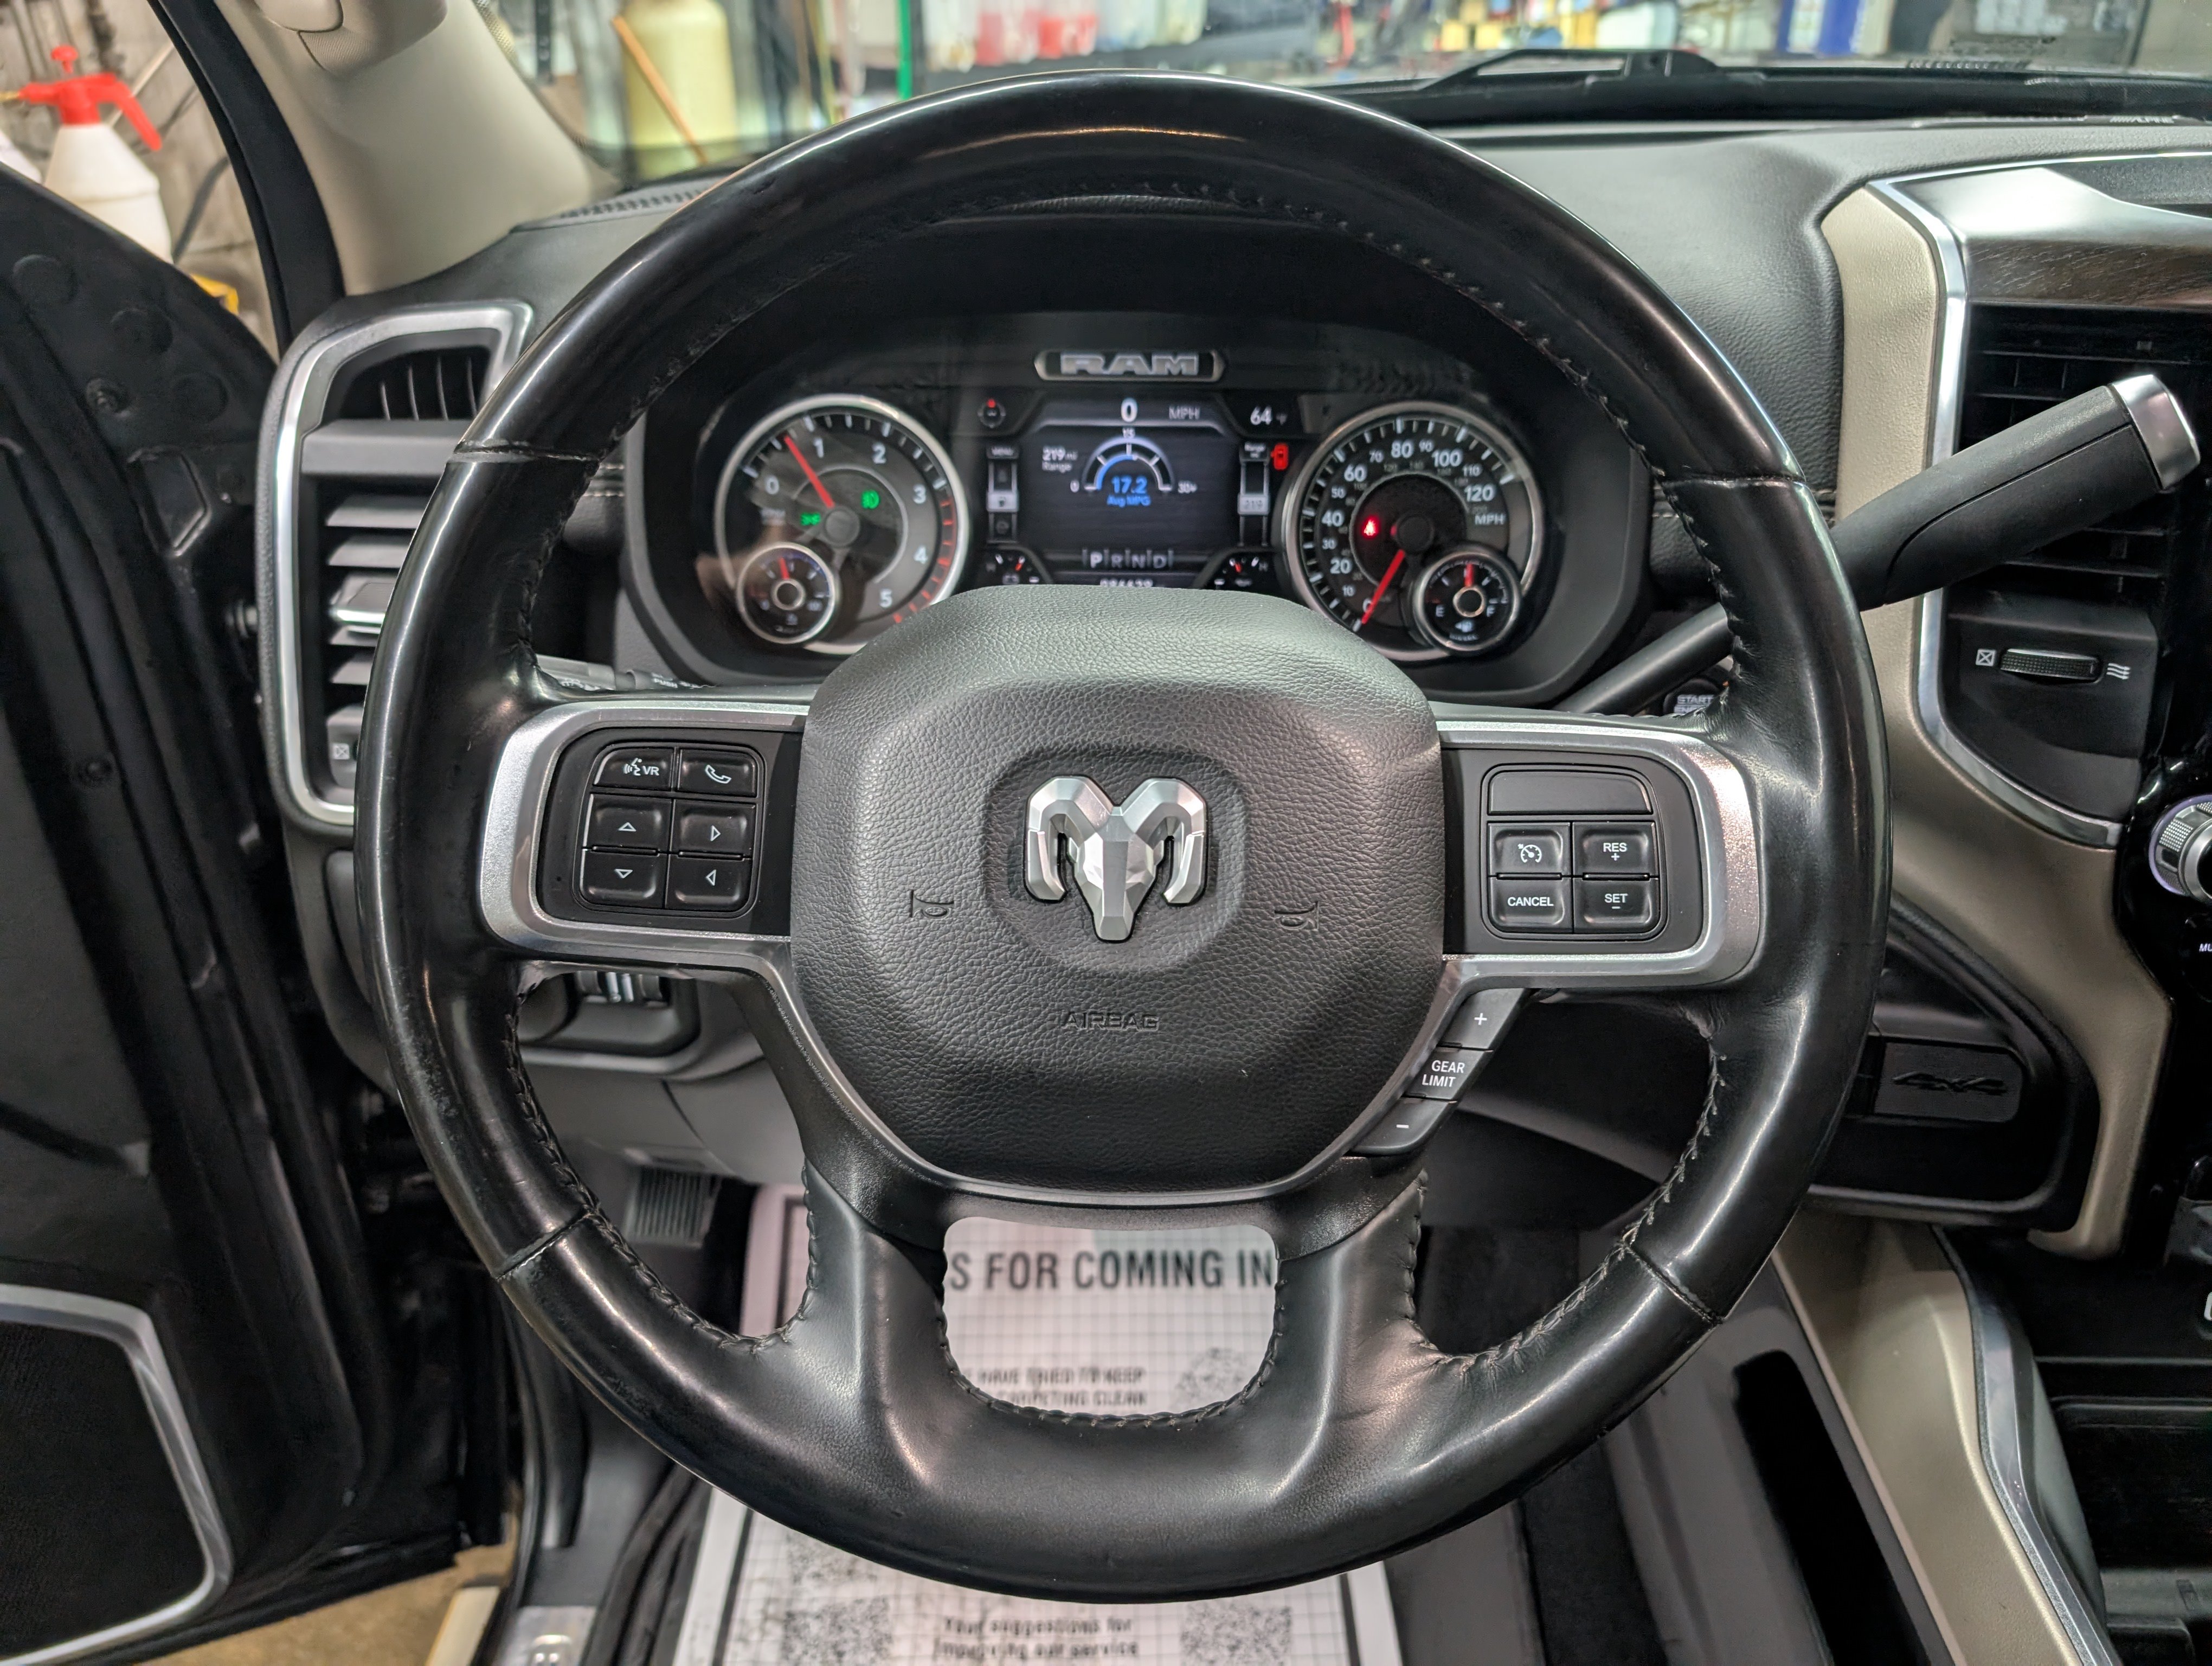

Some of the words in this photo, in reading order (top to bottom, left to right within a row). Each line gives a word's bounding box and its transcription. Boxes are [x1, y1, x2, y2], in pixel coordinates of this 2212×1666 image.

[1060, 353, 1199, 375] RAM
[1121, 398, 1138, 423] 0
[1168, 406, 1201, 420] MPH
[1250, 406, 1272, 426] 64
[815, 437, 825, 458] 1
[871, 443, 886, 465] 2
[1043, 445, 1066, 461] 219
[1391, 440, 1414, 459] 80
[1419, 440, 1433, 452] 90
[1369, 450, 1384, 463] 70
[1431, 449, 1464, 467] 100
[1041, 461, 1073, 473] Range
[1343, 464, 1367, 482] 60
[1463, 464, 1482, 477] 110
[765, 476, 780, 495] 0
[1111, 476, 1148, 494] 17.2
[1331, 486, 1347, 498] 50
[1464, 484, 1496, 502] 120
[914, 485, 927, 503] 3
[1321, 509, 1345, 527] 40
[1475, 514, 1506, 526] MPH
[1322, 538, 1337, 550] 30
[914, 545, 929, 565] 4
[1090, 551, 1103, 568] P
[1131, 553, 1146, 569] N
[1153, 554, 1166, 569] D
[1329, 557, 1353, 574] 20
[879, 590, 893, 608] 5
[1342, 585, 1355, 597] 10
[1436, 605, 1444, 618] E
[1487, 605, 1495, 617] F
[643, 766, 659, 776] VR
[1603, 843, 1627, 853] RES
[1507, 896, 1554, 907] CANCEL
[1604, 893, 1628, 904] SET
[1061, 1012, 1160, 1032] AIRBAG
[1431, 1060, 1465, 1073] GEAR
[1422, 1074, 1456, 1087] LIMIT
[985, 1252, 1058, 1290] FOR
[1073, 1250, 1224, 1289] COMING
[1236, 1250, 1274, 1289] IN
